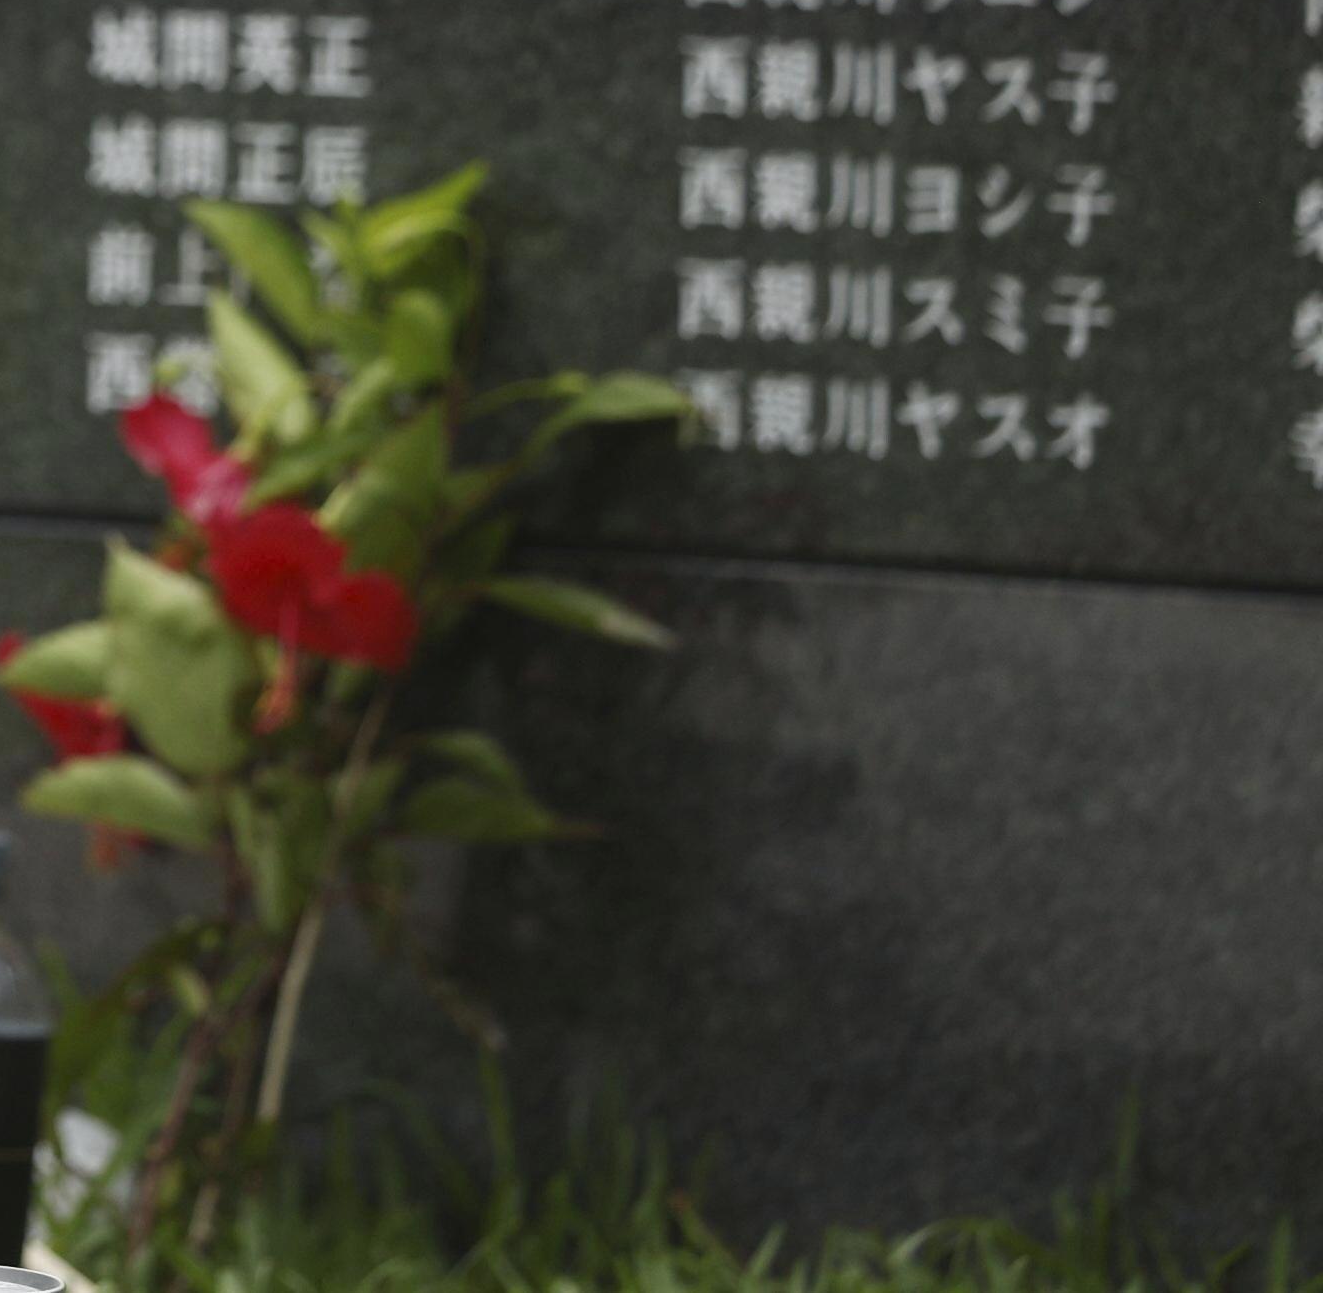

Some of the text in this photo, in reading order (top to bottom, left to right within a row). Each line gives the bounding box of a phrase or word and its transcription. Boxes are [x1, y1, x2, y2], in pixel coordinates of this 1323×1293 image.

[681, 36, 1115, 134] 西親川ヤス子
[680, 147, 1115, 246] 西親川ヨシ子
[678, 257, 1112, 359] 西親川スミ子
